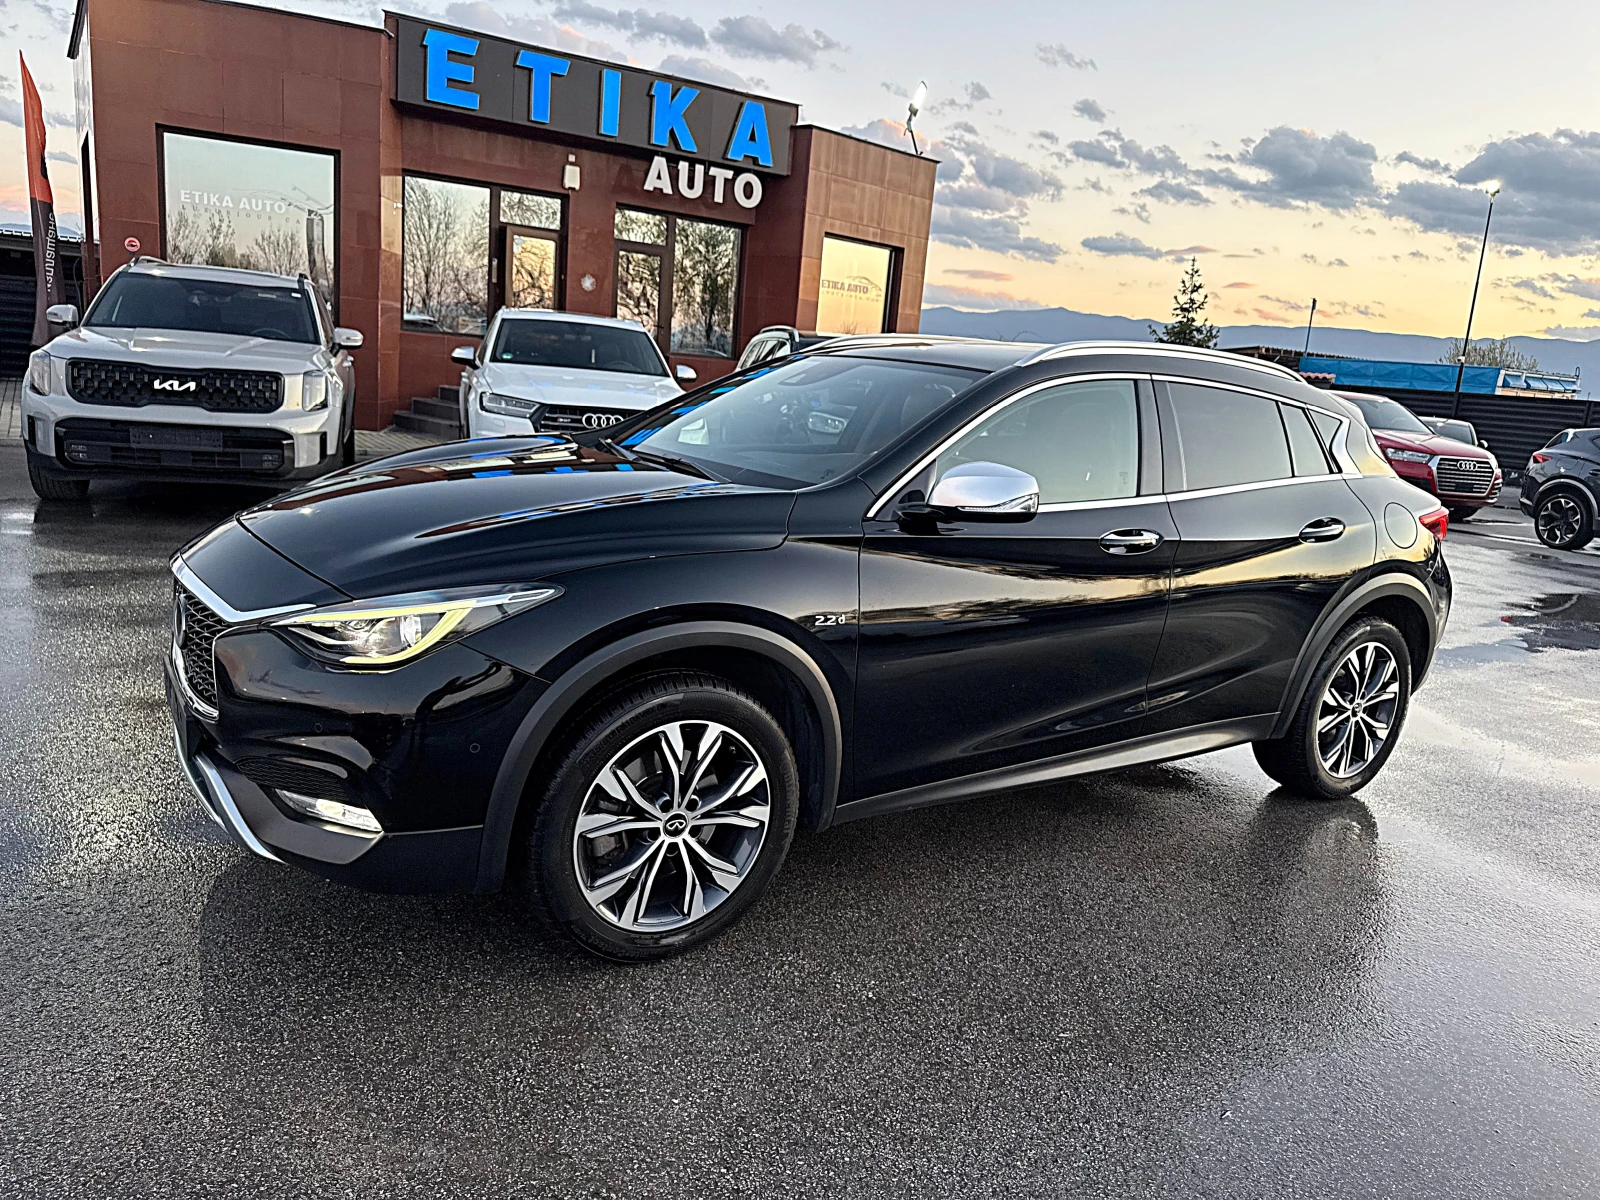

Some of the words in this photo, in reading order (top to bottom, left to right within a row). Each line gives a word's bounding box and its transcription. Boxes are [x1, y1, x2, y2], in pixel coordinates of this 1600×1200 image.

[423, 28, 774, 167] ETIKA
[643, 156, 763, 209] AUTO
[180, 189, 233, 208] ETIKA
[239, 197, 286, 214] AUTO
[821, 279, 845, 291] ETIKA
[847, 283, 869, 294] AUTO
[153, 378, 197, 392] KIA
